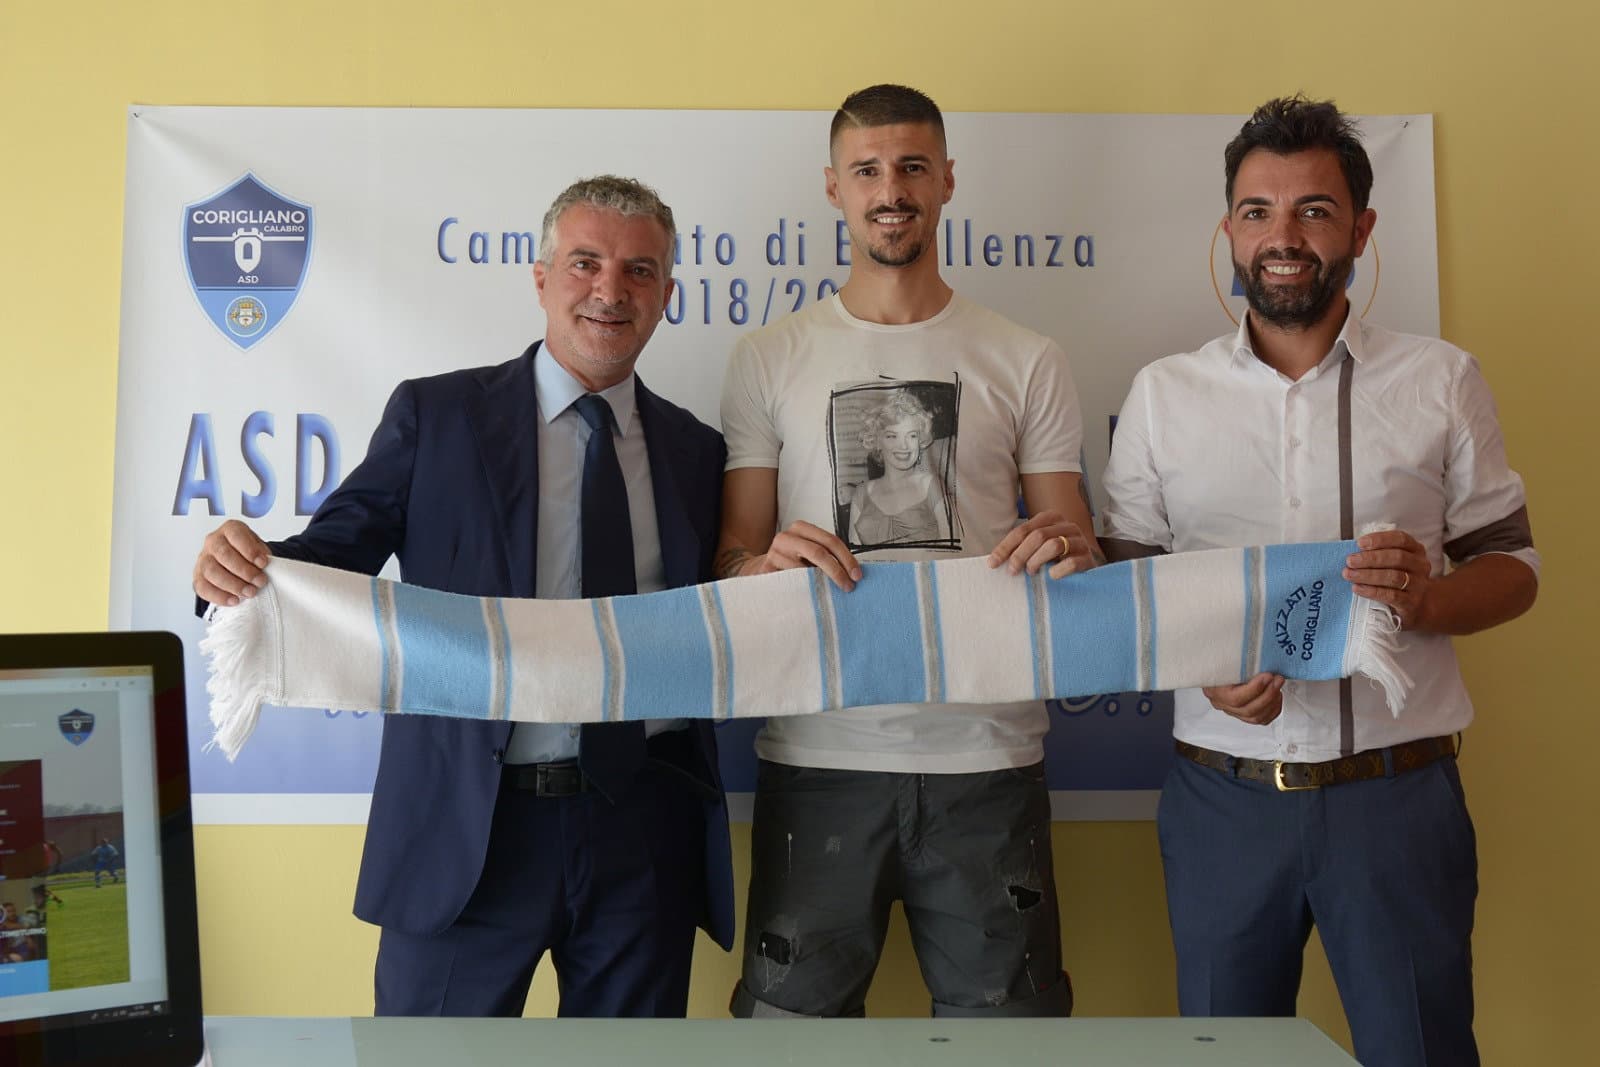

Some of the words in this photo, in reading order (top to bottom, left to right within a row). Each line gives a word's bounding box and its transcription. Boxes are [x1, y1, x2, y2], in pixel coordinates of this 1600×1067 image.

[192, 210, 305, 224] CORIGLIANO
[765, 218, 805, 266] di
[237, 275, 259, 284] ASD
[171, 410, 342, 519] ASD
[1275, 586, 1307, 656] SKIZZATI
[1301, 580, 1324, 661] CORIGLIANO
